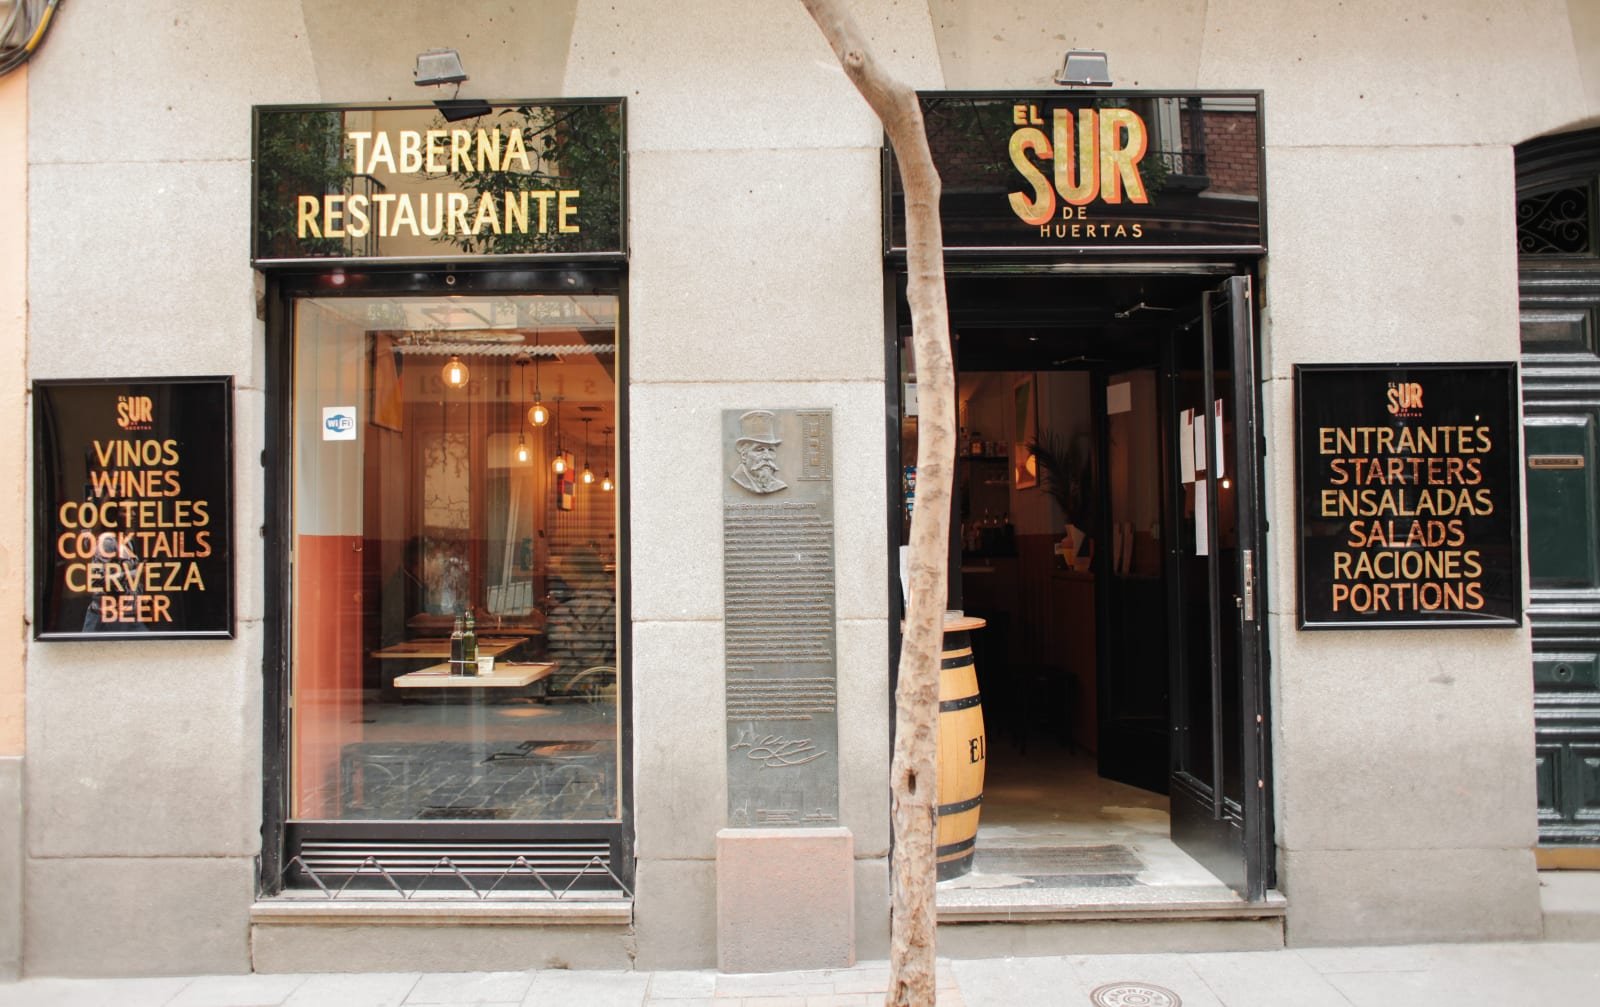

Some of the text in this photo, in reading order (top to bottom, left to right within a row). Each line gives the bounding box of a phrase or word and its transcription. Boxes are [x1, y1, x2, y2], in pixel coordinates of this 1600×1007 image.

[1013, 105, 1043, 125] EL
[349, 128, 531, 174] TABERNA
[1008, 108, 1148, 225] SUR
[297, 190, 580, 238] RESTAURANTE
[1063, 207, 1087, 219] DE
[1040, 224, 1143, 238] HUERTAS
[117, 396, 153, 427] SUR
[1386, 382, 1423, 414] SUR
[93, 439, 180, 467] VINOS
[1319, 426, 1493, 455] ENTRANTES
[91, 470, 182, 498] WINES
[1330, 457, 1483, 486] STARTERS
[59, 496, 210, 529] CÓCTELES
[1321, 488, 1495, 518] ENSALADAS
[58, 531, 213, 560] COCKTAILS
[1347, 519, 1466, 548] SALADS
[65, 562, 206, 592] CERVEZA
[1333, 550, 1483, 580] RACIONES
[101, 595, 173, 624] BEER
[1332, 581, 1485, 612] PORTIONS
